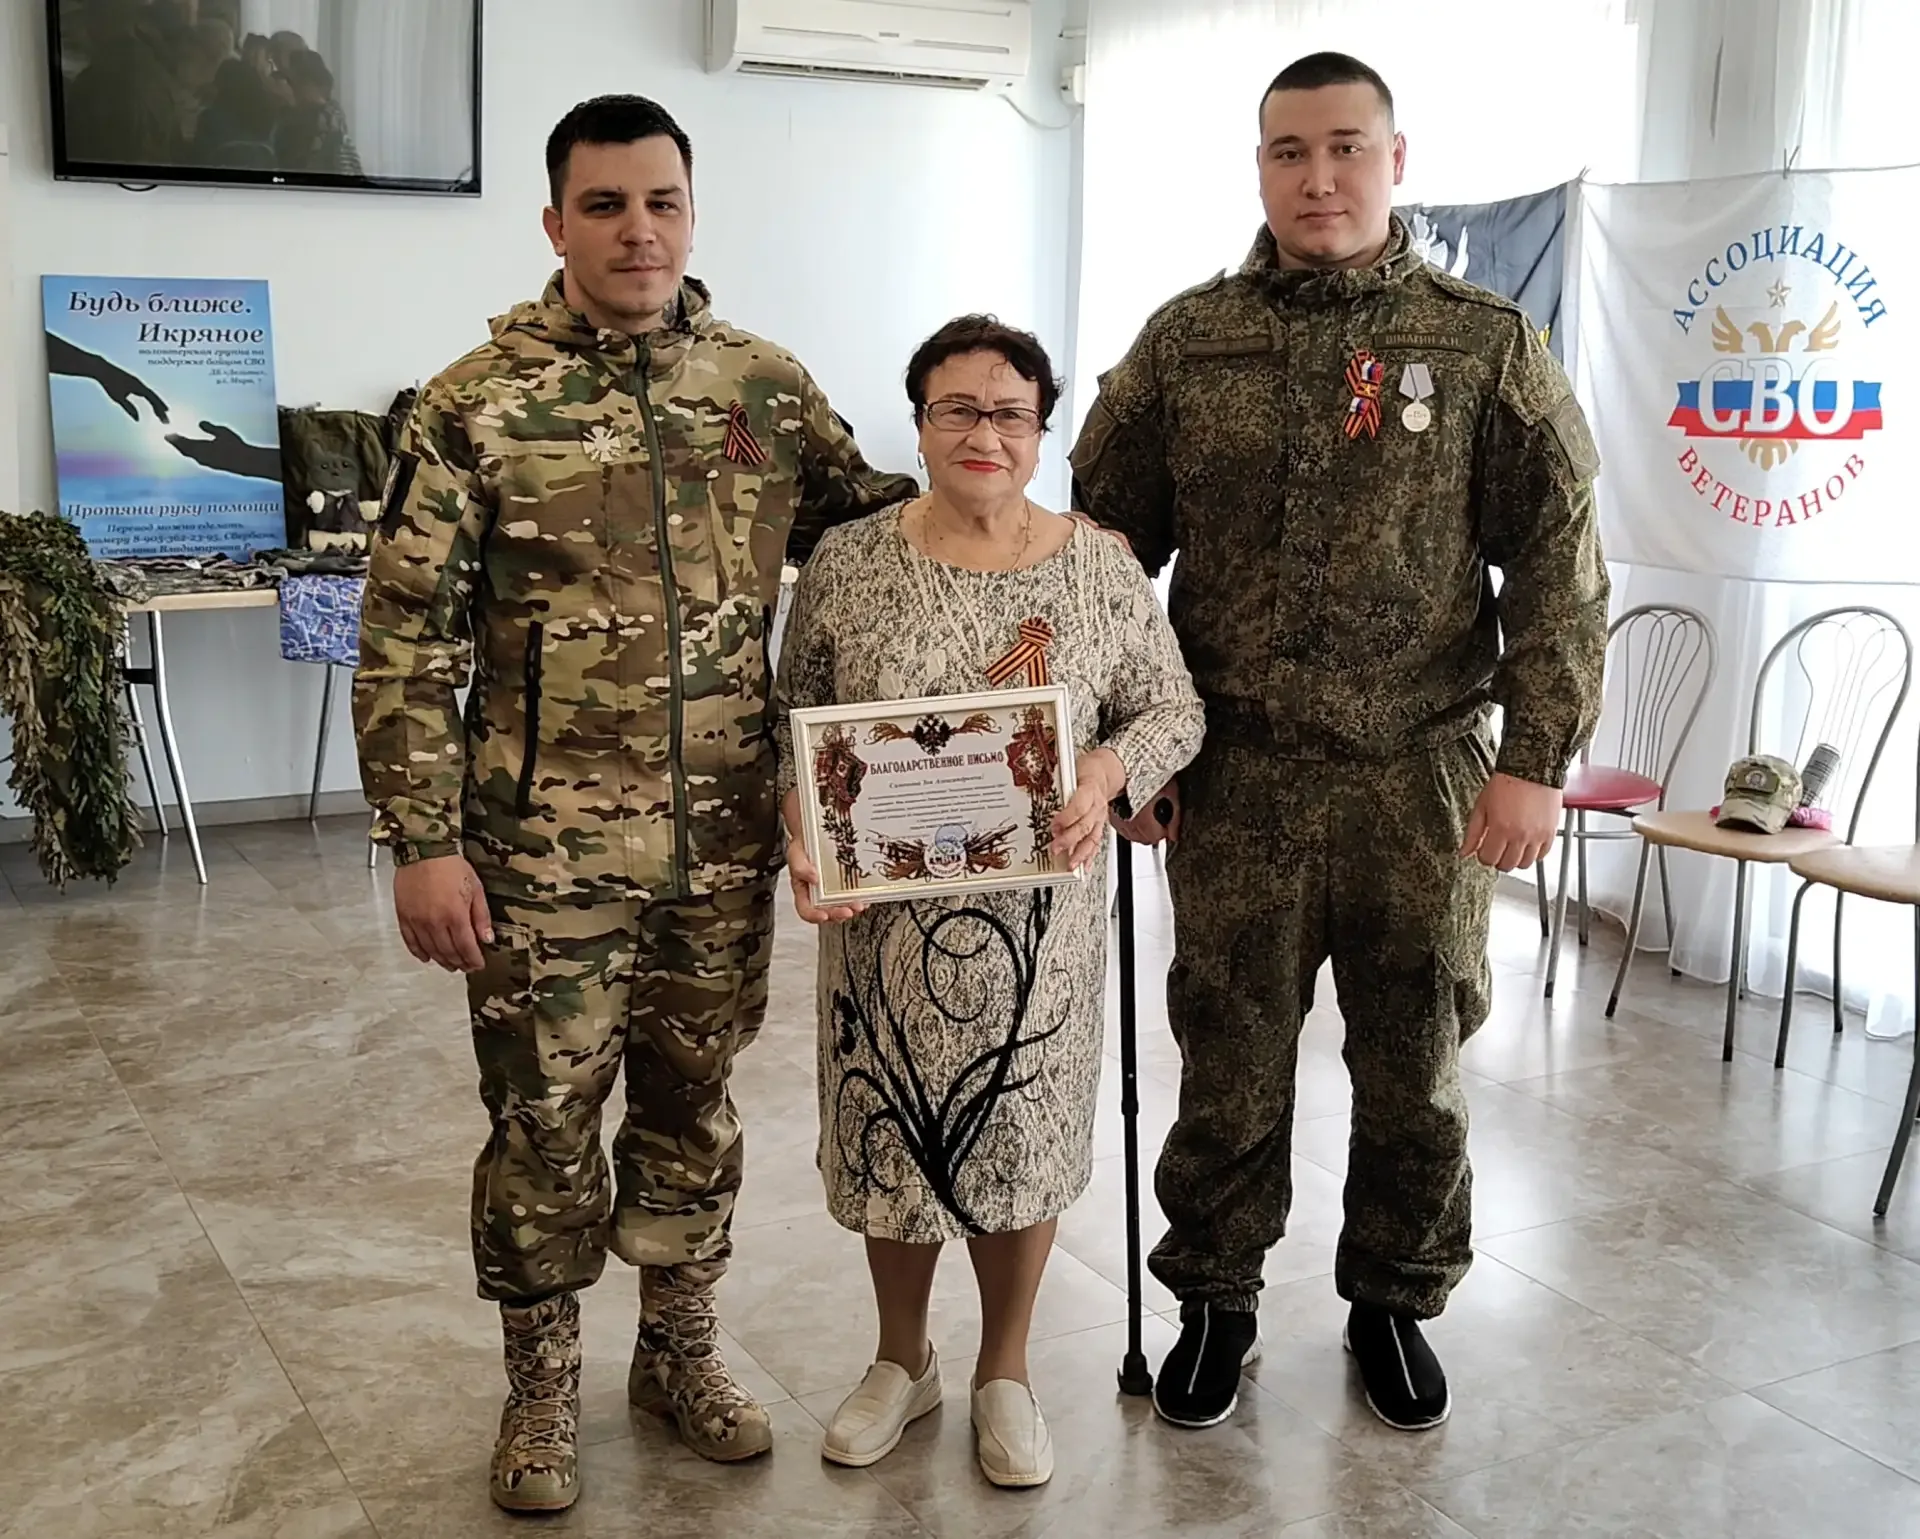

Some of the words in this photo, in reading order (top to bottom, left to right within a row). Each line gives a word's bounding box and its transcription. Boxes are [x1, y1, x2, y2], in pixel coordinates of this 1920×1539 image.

[1673, 225, 1887, 335] АССОЦИАЦИЯ
[68, 290, 140, 317] Будь
[148, 292, 252, 314] ближе.
[137, 322, 264, 347] Икряное
[244, 357, 265, 366] СВО
[1698, 357, 1855, 436] СВО
[1677, 445, 1865, 527] ВЕТЕРАНОВ
[67, 503, 154, 519] Протяни
[159, 502, 201, 517] руку
[207, 501, 280, 515] помощи
[870, 754, 964, 775] БЛАГОДАРСТВЕННОЕ
[967, 751, 1004, 765] ПИСЬМО
